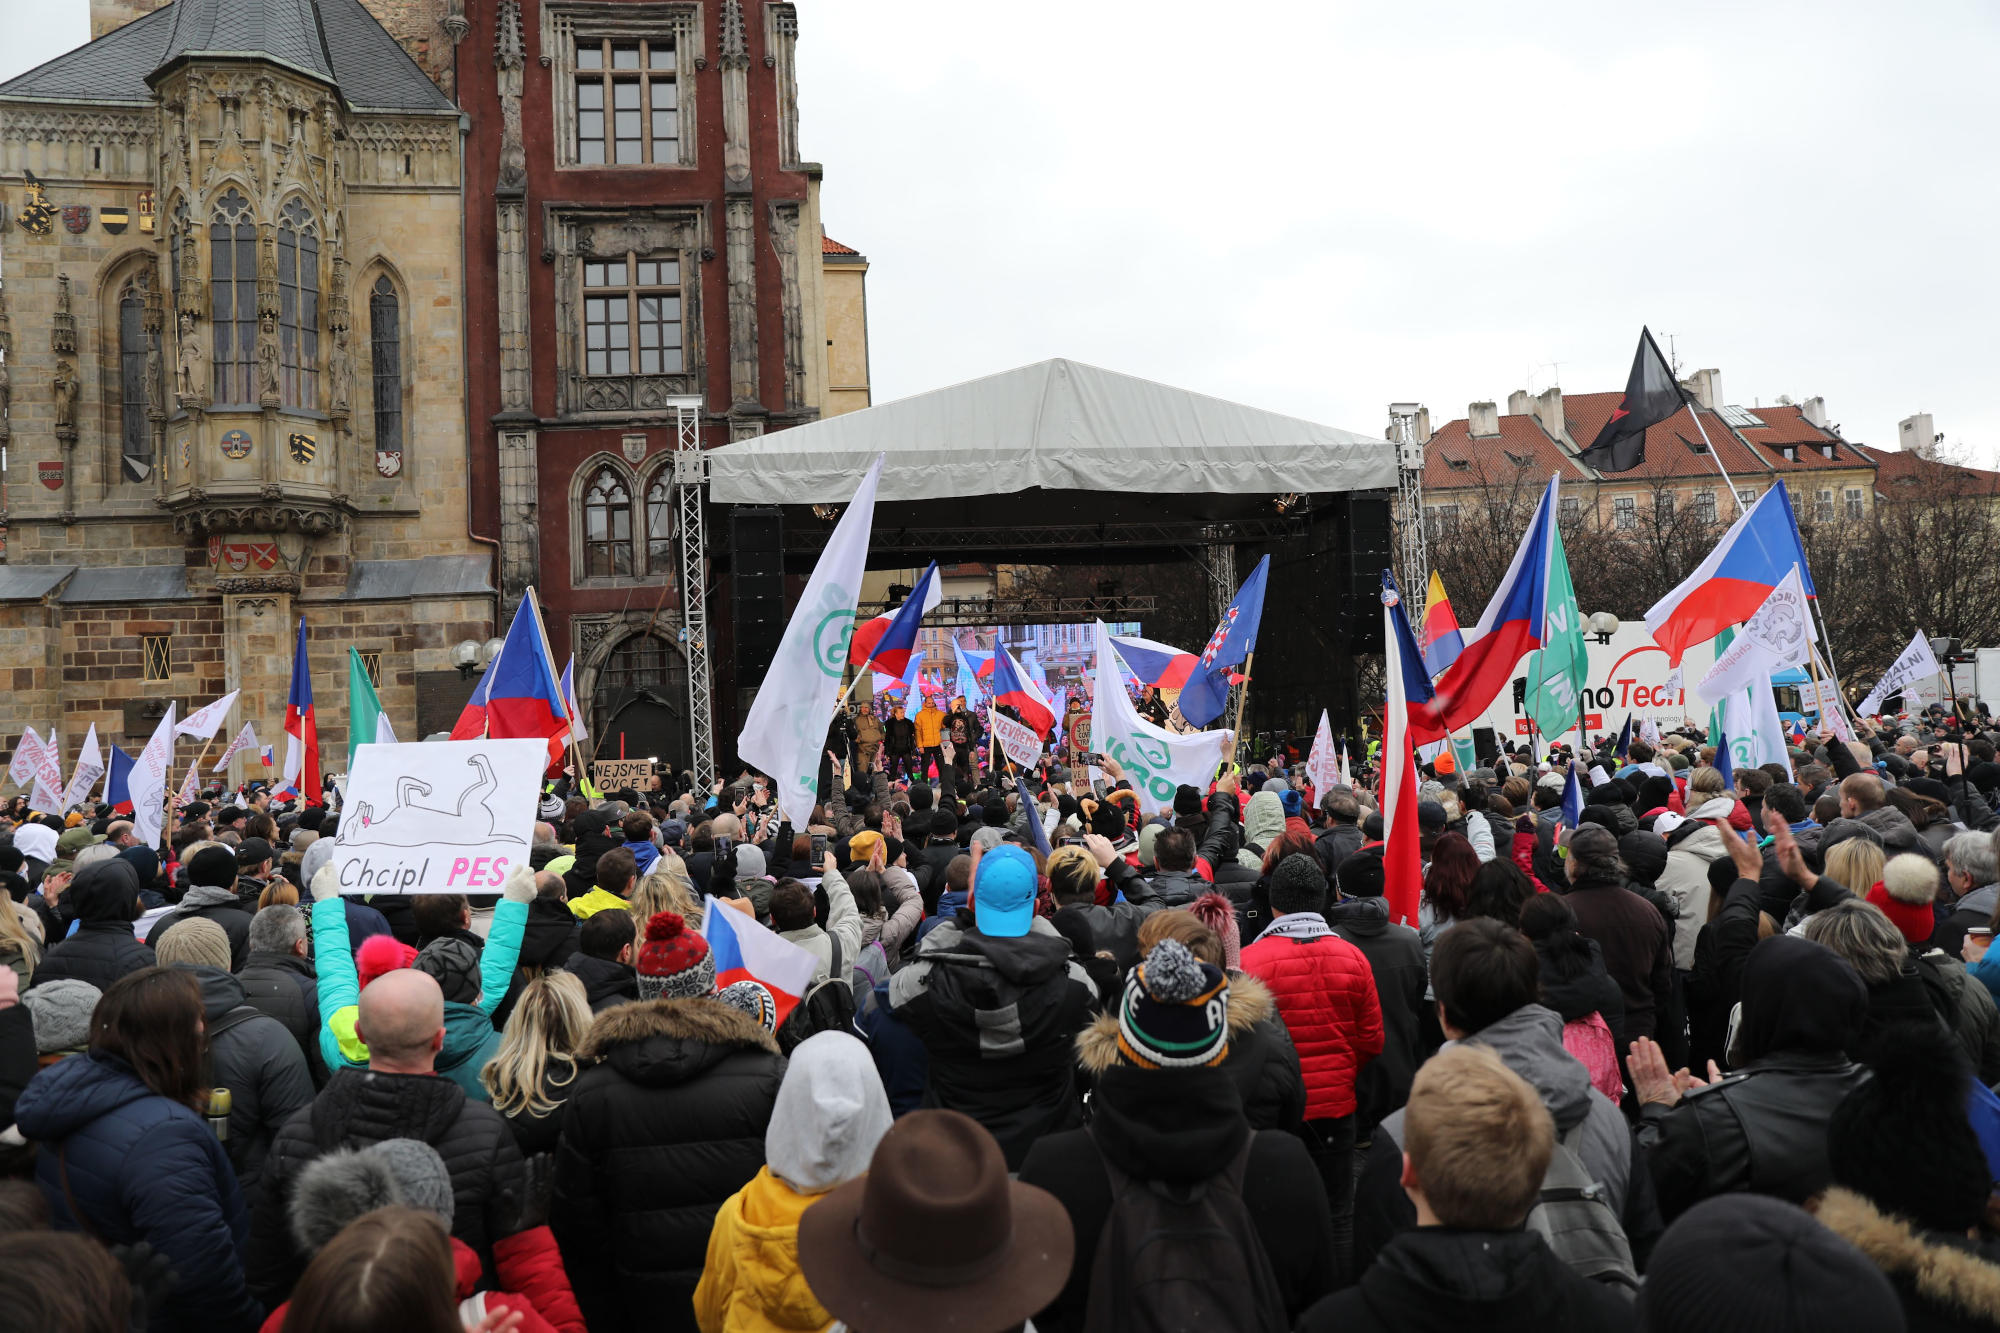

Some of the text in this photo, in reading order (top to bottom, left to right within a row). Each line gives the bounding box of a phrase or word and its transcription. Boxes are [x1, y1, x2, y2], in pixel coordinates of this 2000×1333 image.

[994, 716, 1040, 751] TEVŘEME
[1077, 723, 1090, 733] STO
[1519, 723, 1534, 732] ligt
[595, 763, 648, 778] NEJSME
[340, 856, 509, 894] Chcipl PES
